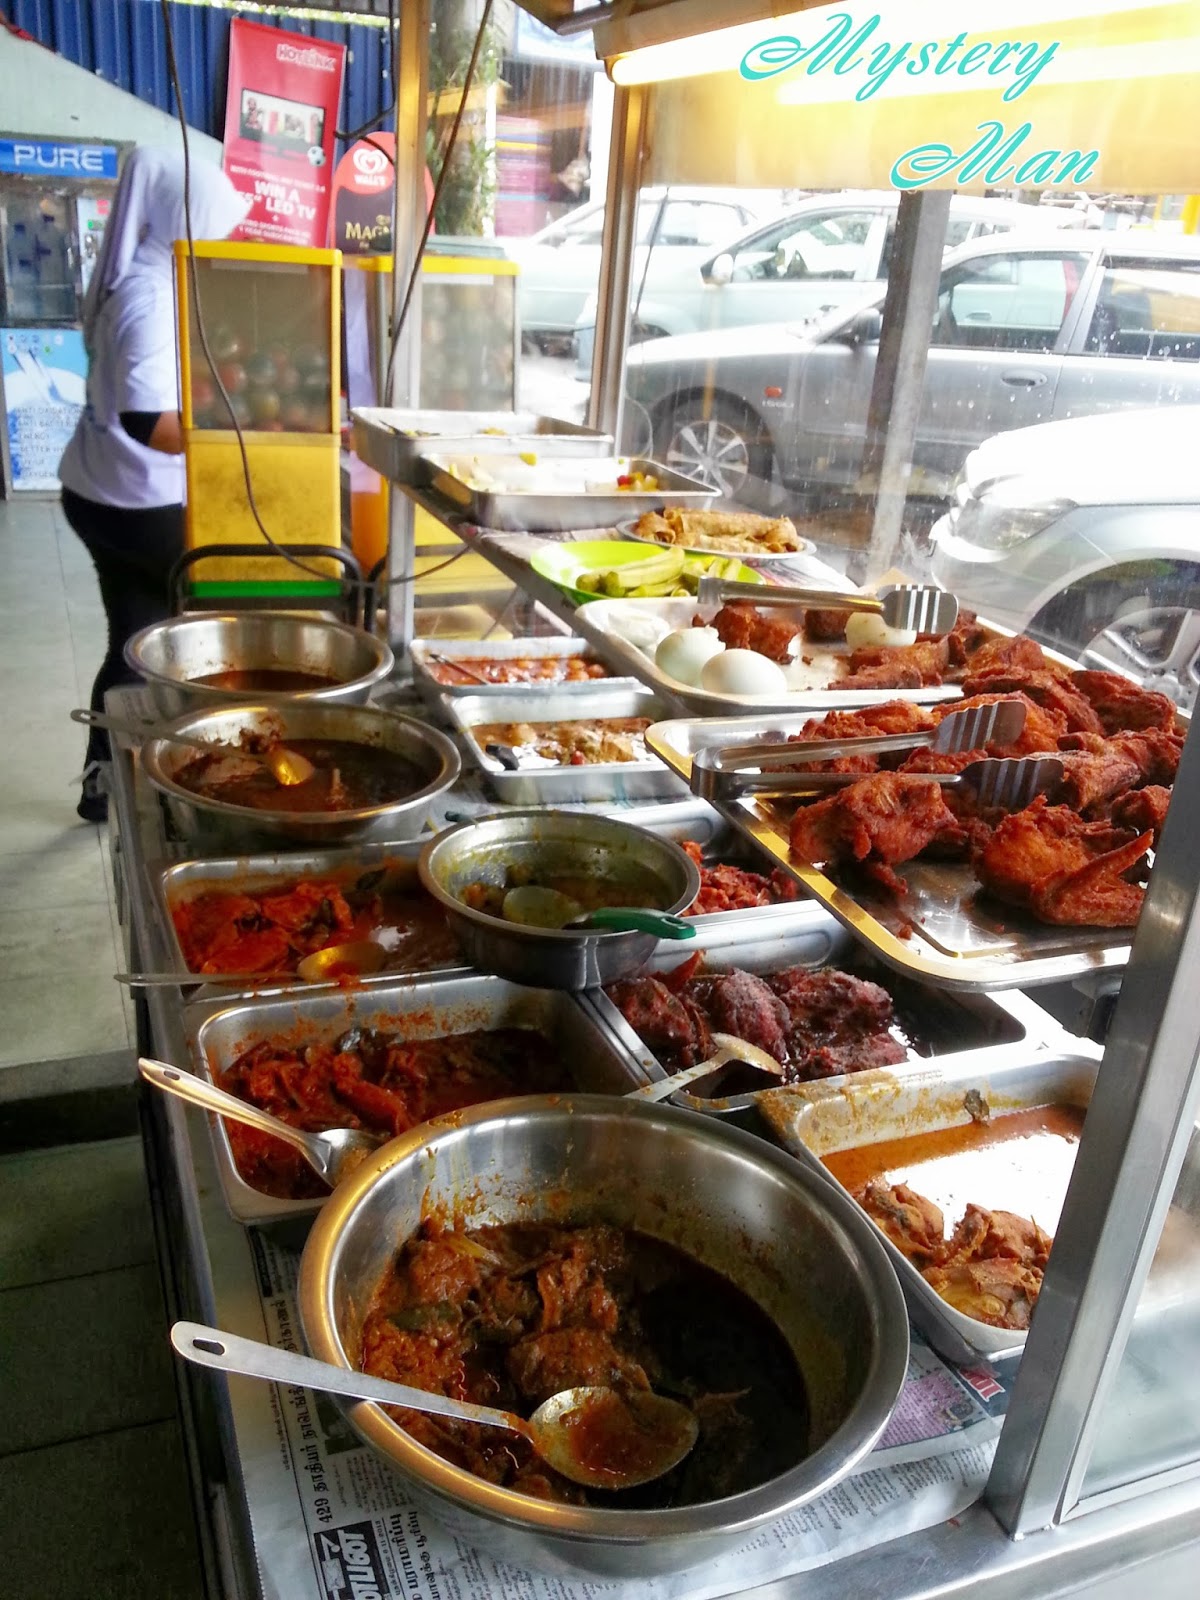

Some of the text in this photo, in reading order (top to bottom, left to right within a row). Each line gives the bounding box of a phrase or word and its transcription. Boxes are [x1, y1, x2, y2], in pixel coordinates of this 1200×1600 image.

[13, 143, 104, 171] PURE
[289, 1386, 318, 1440] நாடெங்கி
[300, 1444, 329, 1493] தாதியர்
[314, 1498, 333, 1523] 429
[420, 1552, 440, 1600] யாவுக்கு
